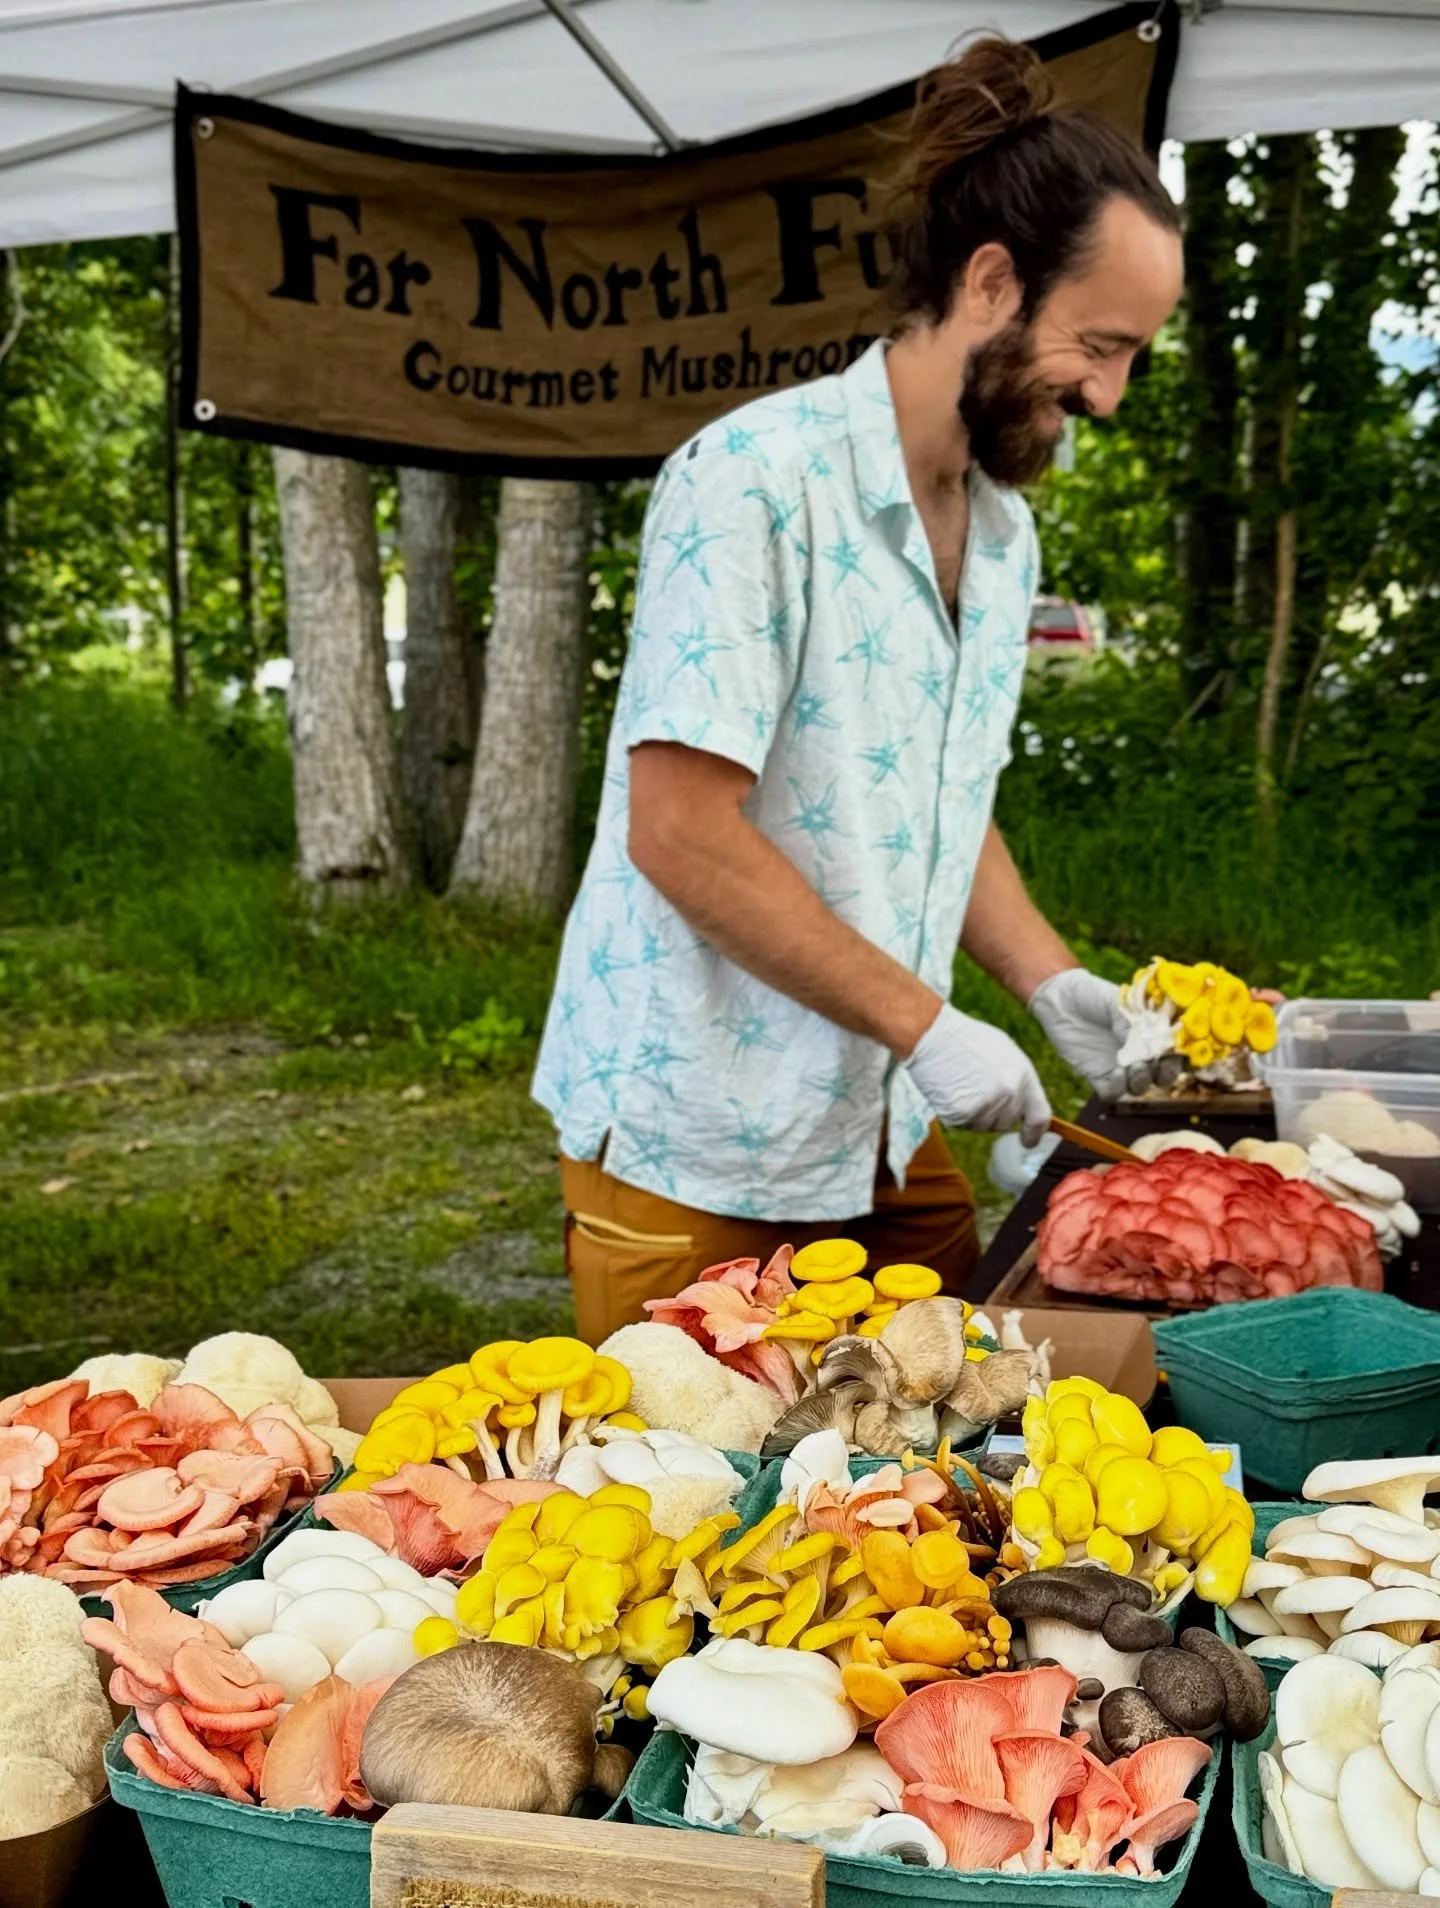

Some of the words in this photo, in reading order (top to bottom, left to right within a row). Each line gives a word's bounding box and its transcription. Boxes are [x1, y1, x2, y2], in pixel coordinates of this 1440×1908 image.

[267, 183, 432, 316] Far
[462, 207, 728, 332] North
[404, 340, 619, 406] Gourmet
